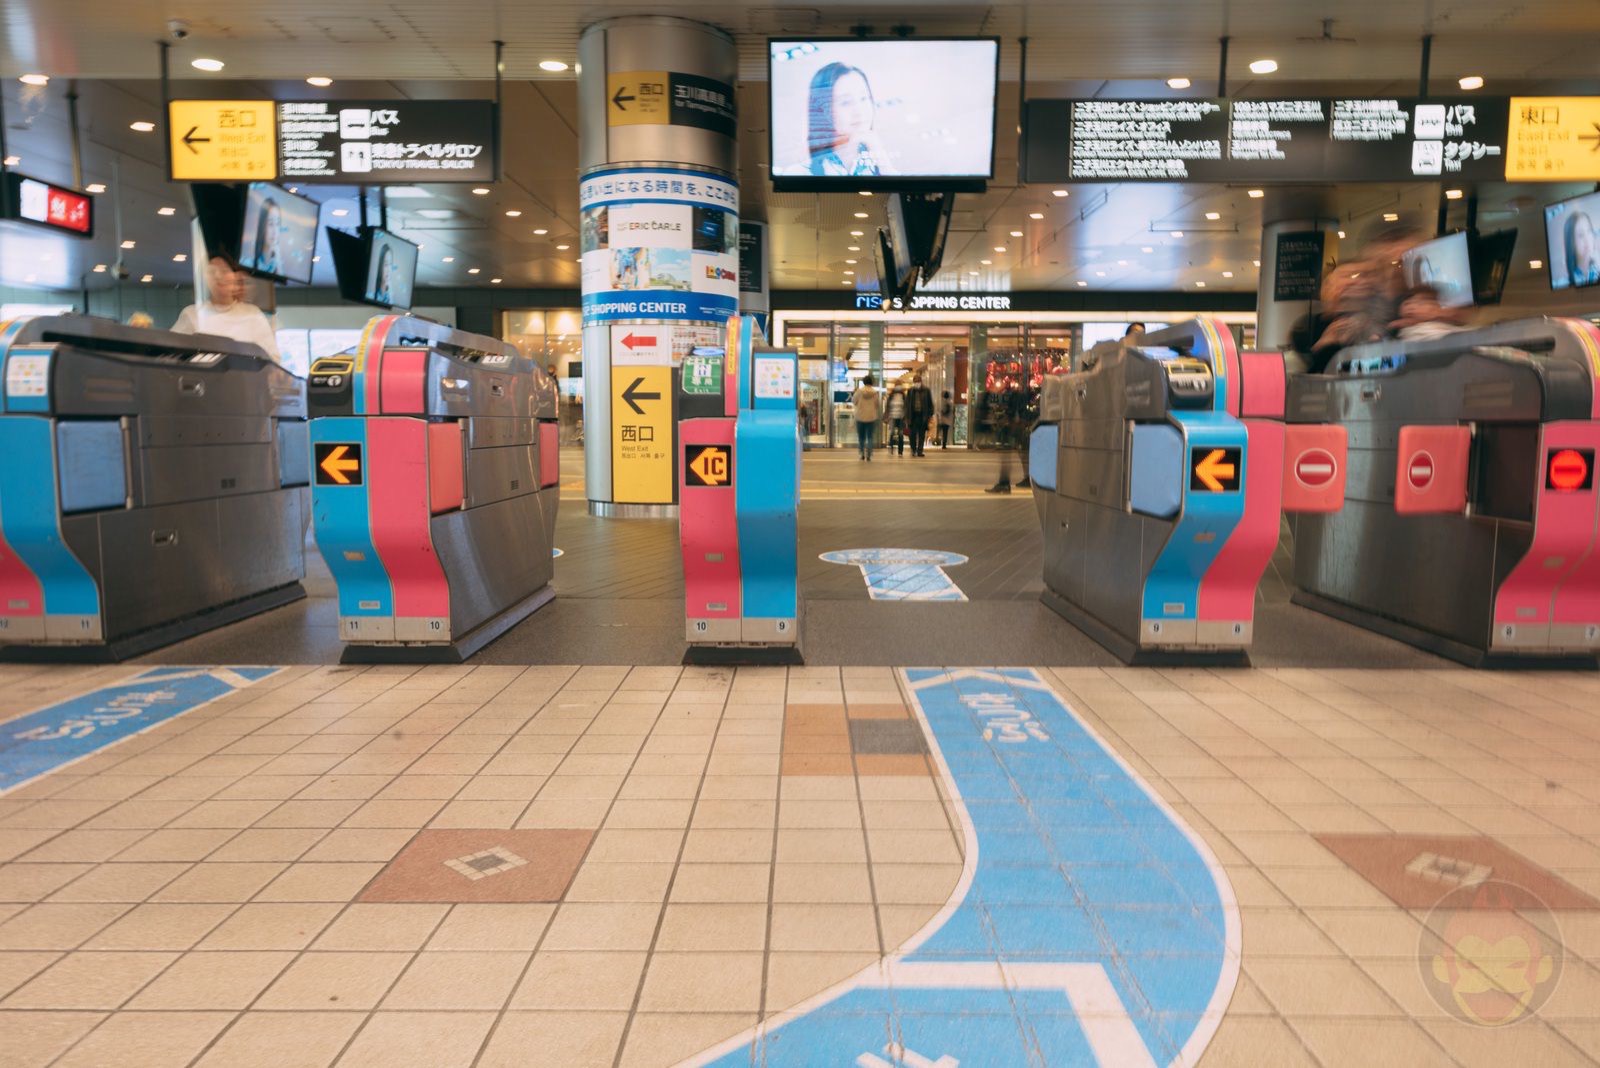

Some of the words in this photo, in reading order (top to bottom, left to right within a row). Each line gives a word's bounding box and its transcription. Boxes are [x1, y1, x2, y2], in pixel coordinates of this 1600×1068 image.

[370, 109, 400, 125] バス
[1446, 104, 1476, 125] バス
[1520, 105, 1560, 125] 東口
[1444, 141, 1501, 161] タクシー
[405, 159, 440, 169] TRAVEL
[441, 159, 475, 169] SALON
[628, 222, 650, 231] ERIC
[591, 303, 637, 314] SHOPPING
[639, 302, 687, 313] CENTER
[856, 296, 882, 309] ris
[959, 296, 1011, 310] CENTER
[621, 425, 654, 442] 西口
[703, 457, 724, 476] IC
[349, 621, 359, 630] 11
[429, 621, 440, 630] 10
[696, 621, 707, 631] 10
[779, 621, 786, 631] 9
